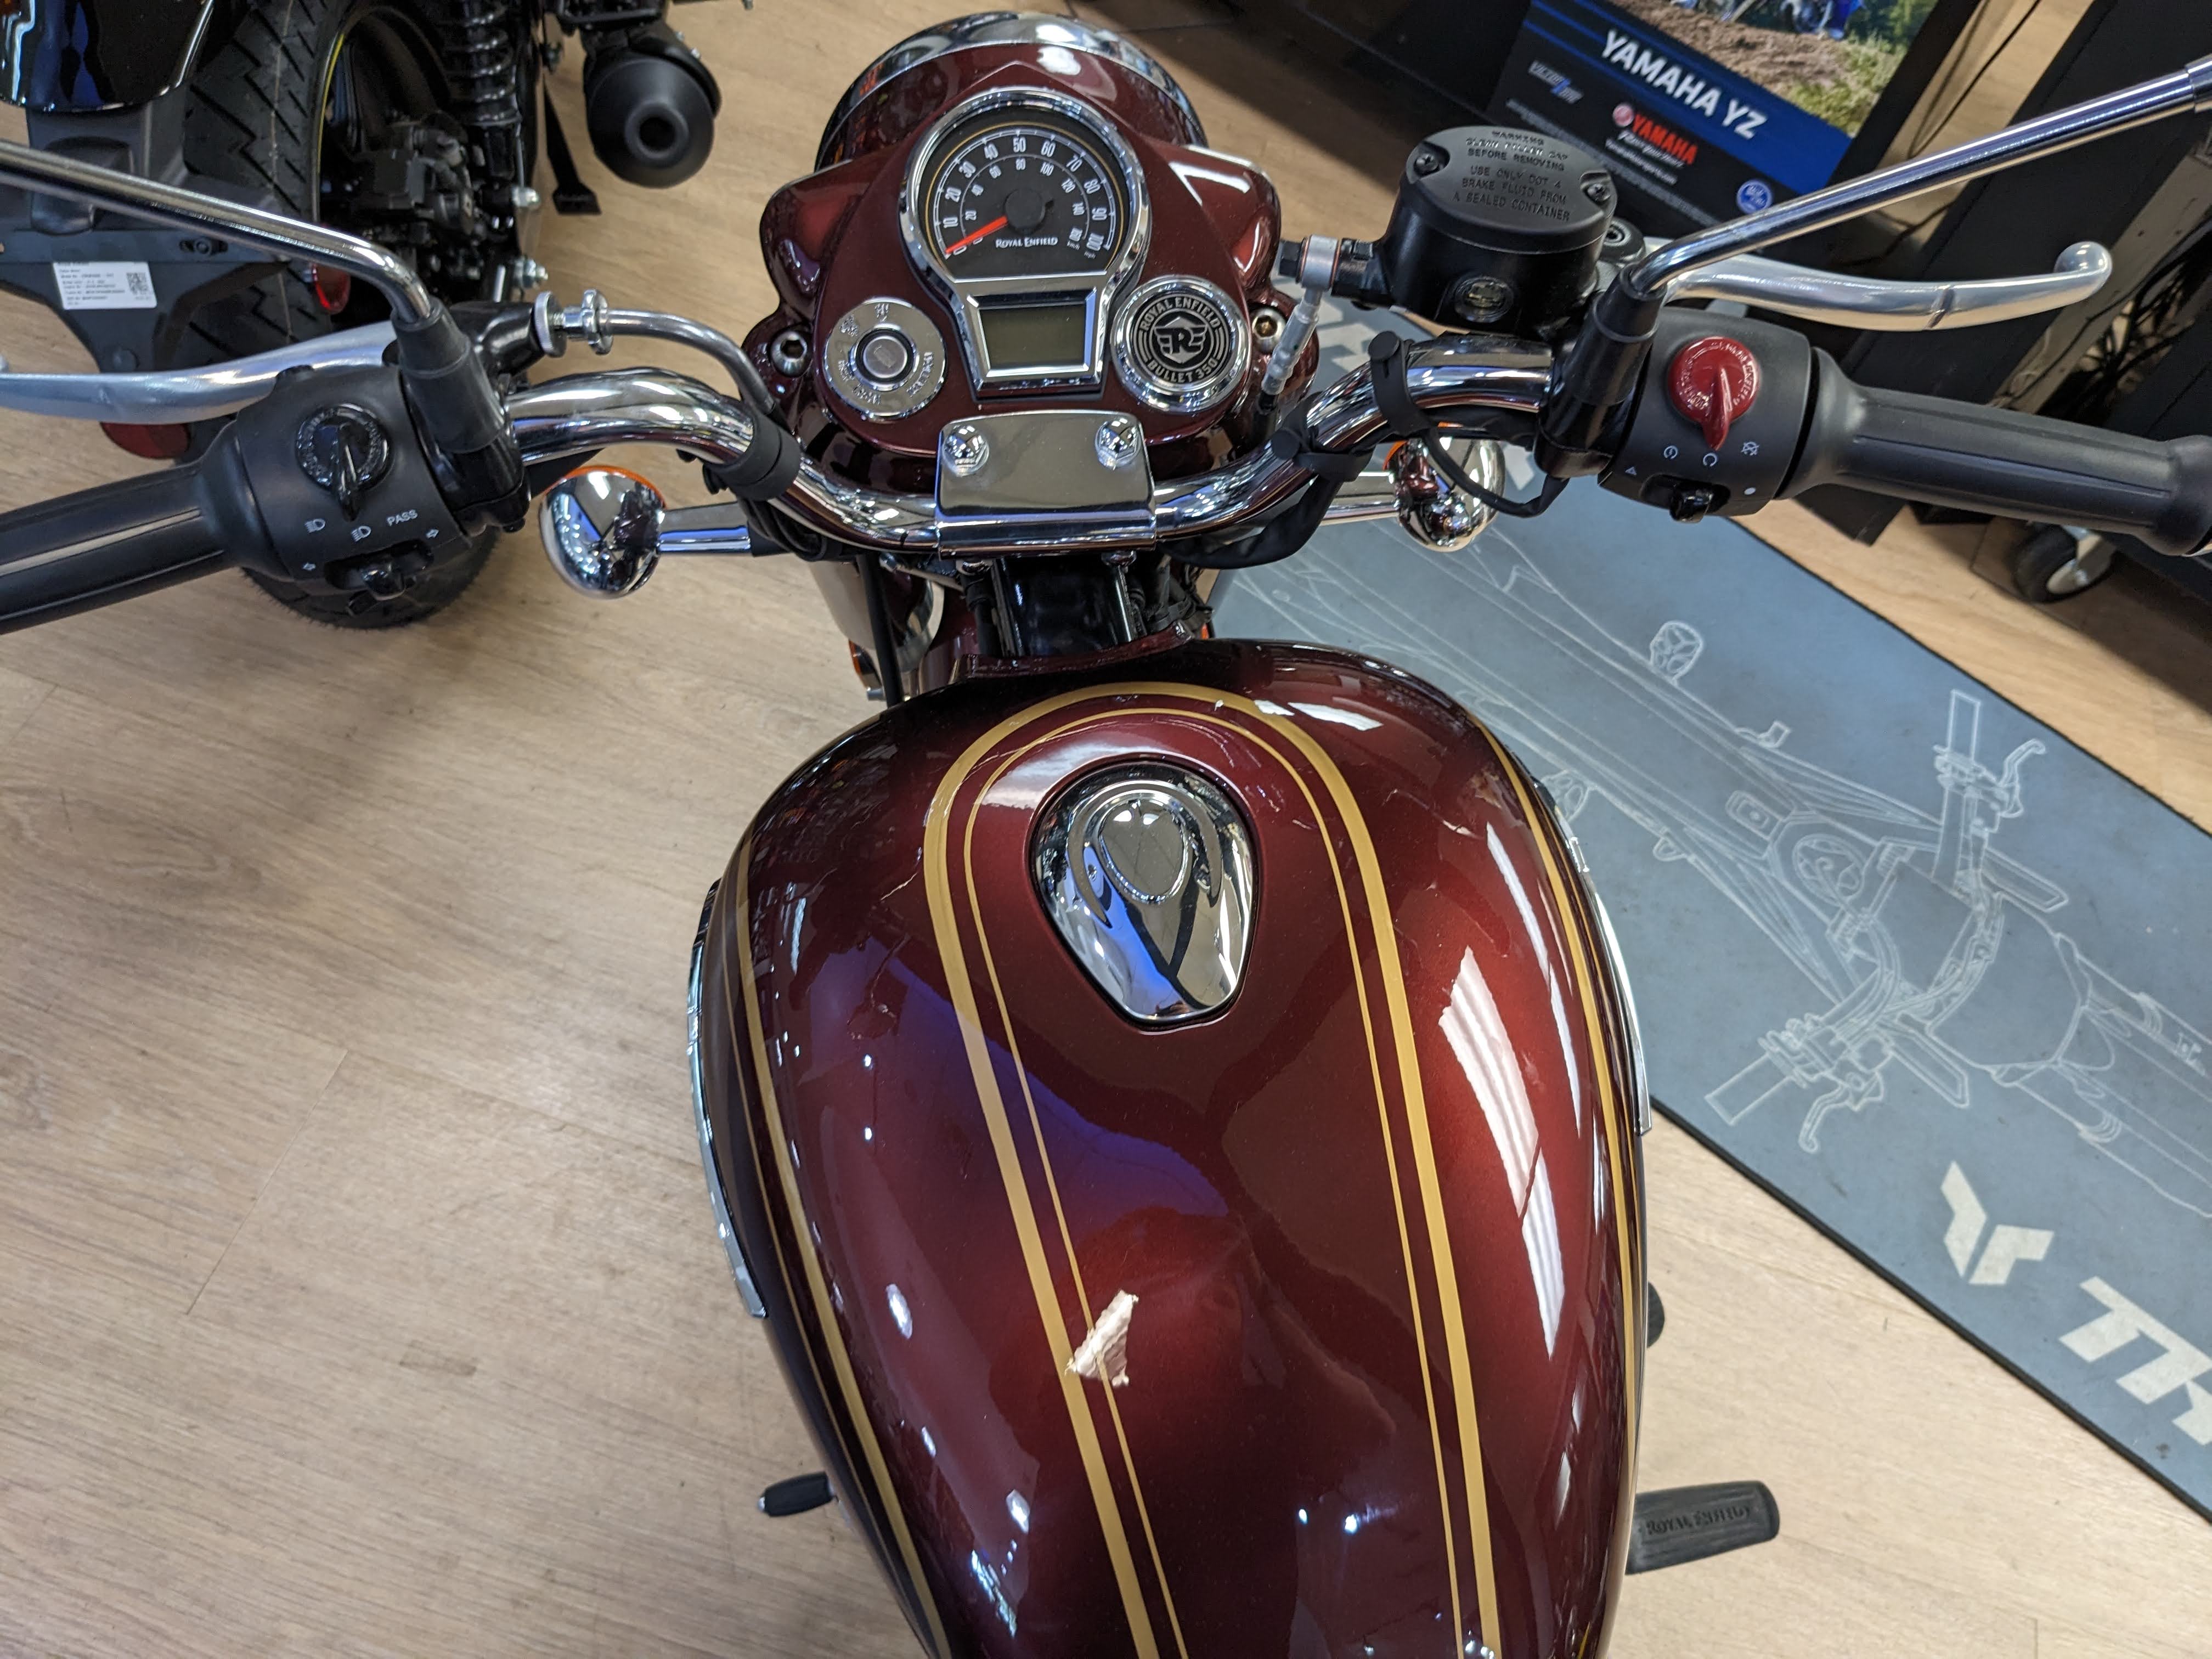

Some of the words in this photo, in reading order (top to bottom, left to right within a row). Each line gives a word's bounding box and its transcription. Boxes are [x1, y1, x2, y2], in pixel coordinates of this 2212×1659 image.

[1601, 29, 1722, 117] YAMAHA
[1722, 99, 1768, 140] YZ
[1013, 137, 1026, 153] 50
[1492, 131, 1544, 146] WARNING
[1632, 113, 1698, 165] YAMAHA
[984, 144, 998, 160] 40
[1041, 142, 1056, 157] 60
[1015, 157, 1026, 171] 80
[1066, 155, 1082, 172] 70
[1468, 148, 1507, 160] BEFORE
[1514, 154, 1565, 171] REMOVING
[959, 161, 976, 178] 30
[1040, 162, 1054, 176] 100
[1470, 165, 1491, 176] USE
[1497, 167, 1525, 180] ONLY
[1529, 174, 1549, 185] DOT
[971, 183, 984, 196] 40
[1061, 178, 1076, 193] 120
[1084, 179, 1101, 194] 80
[1462, 178, 1496, 190] BRAKE
[1502, 182, 1535, 198] FLUID
[1540, 190, 1567, 205] FROM
[945, 187, 961, 202] 20
[1073, 201, 1085, 216] 140
[1092, 206, 1107, 220] 90
[1453, 191, 1460, 202] A
[1466, 192, 1506, 207] SEALED
[1511, 198, 1570, 222] CONTAINER
[943, 216, 958, 228] 10
[965, 210, 977, 221] 20
[995, 239, 1023, 249] ROYAL
[1024, 236, 1058, 247] ENFIELD
[1086, 233, 1105, 251] 100
[1139, 299, 1173, 331] ROYAL
[1175, 297, 1222, 329] ENFIELD
[1147, 359, 1194, 383] BULLET
[1197, 359, 1218, 379] 350
[387, 510, 418, 526] PASS
